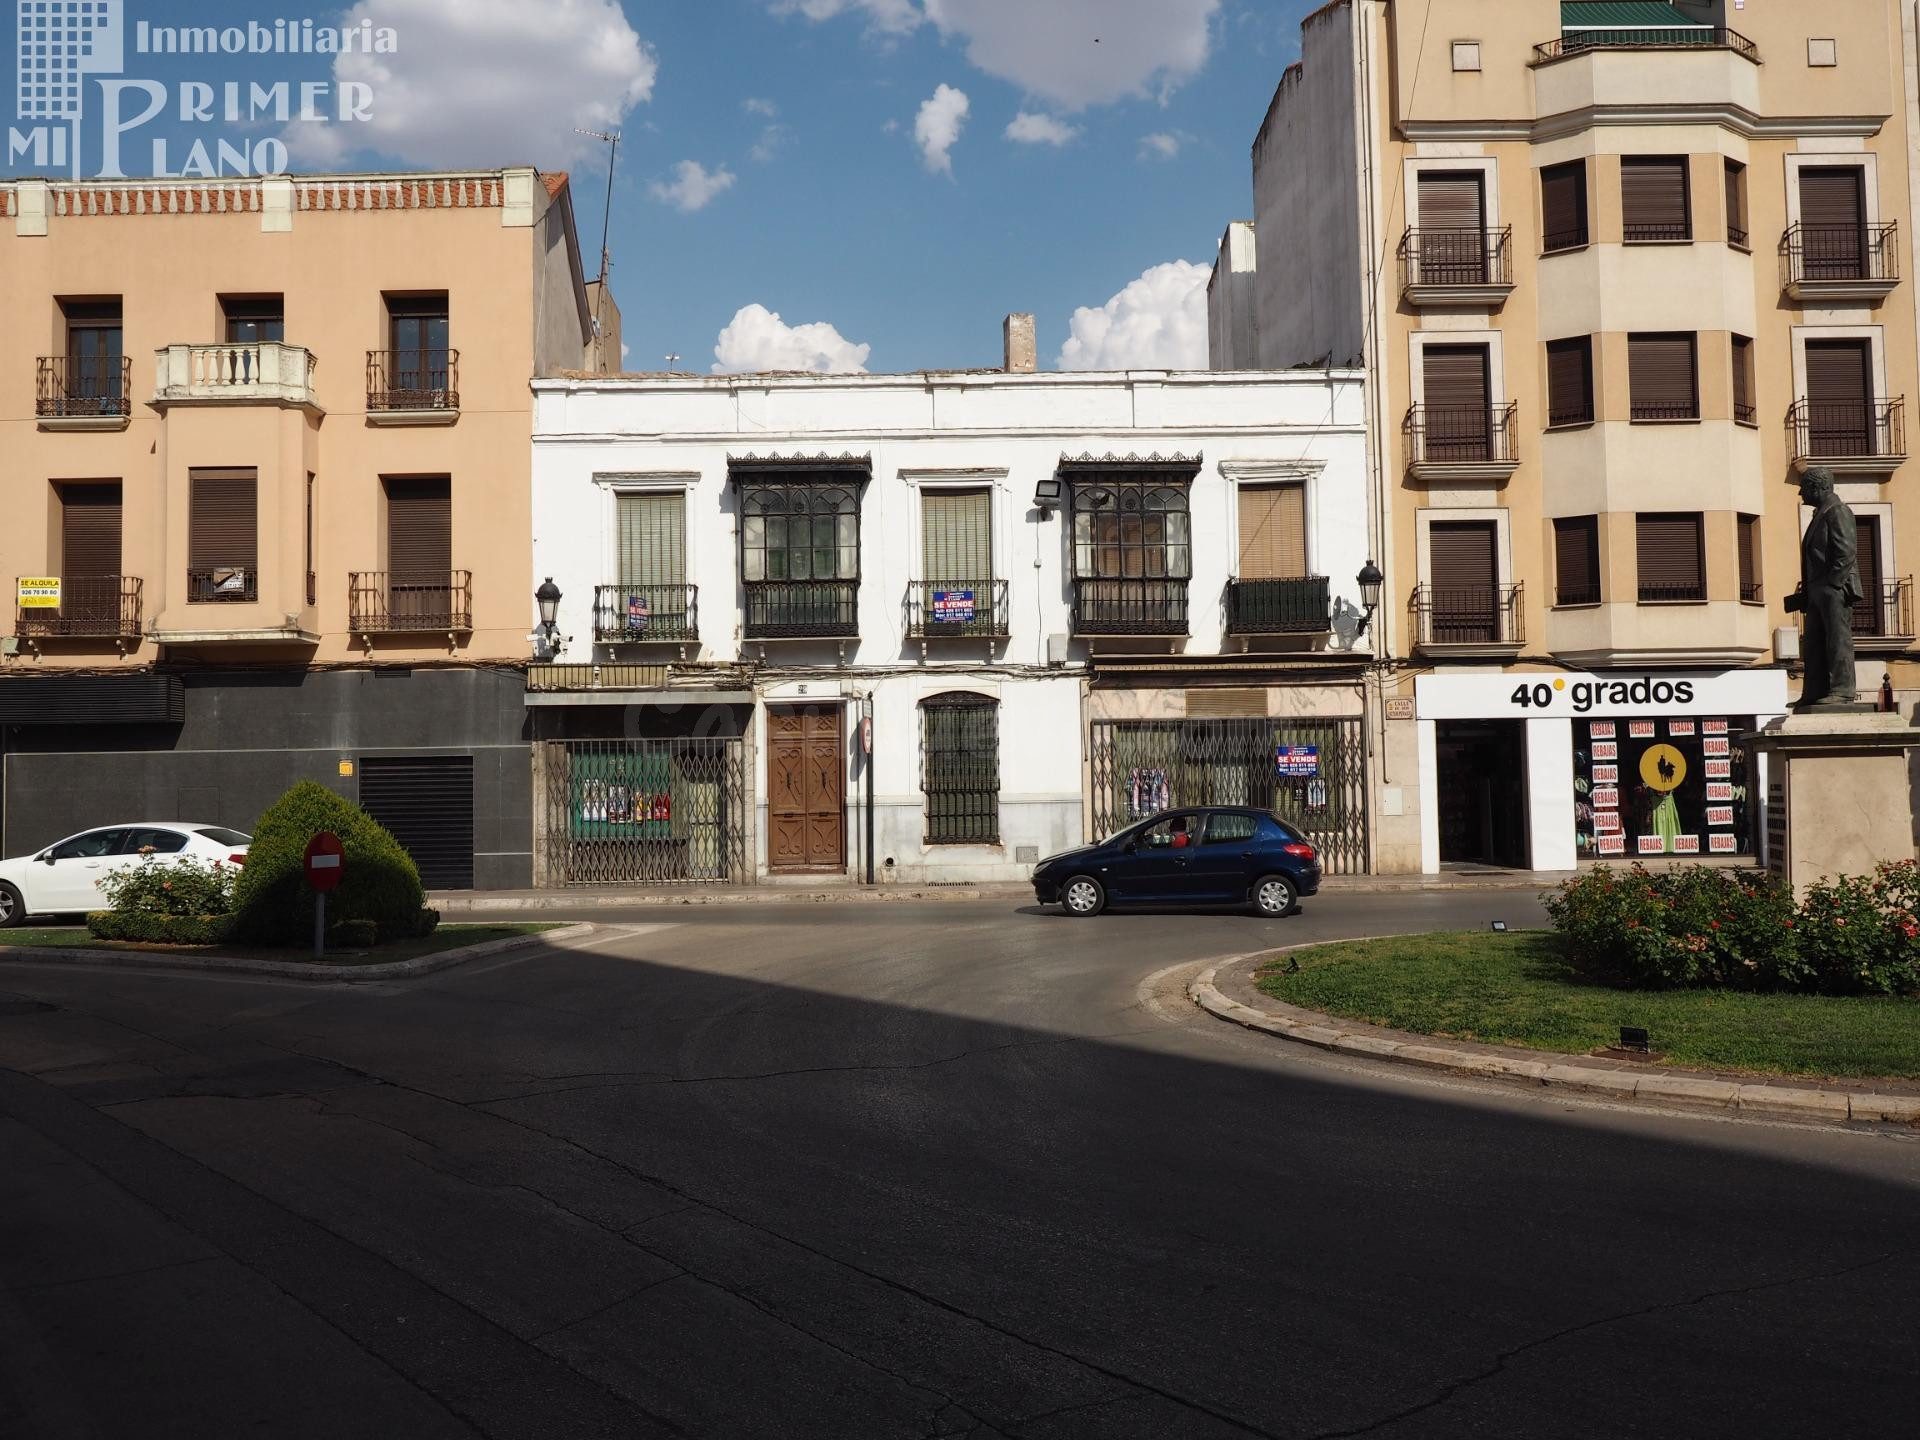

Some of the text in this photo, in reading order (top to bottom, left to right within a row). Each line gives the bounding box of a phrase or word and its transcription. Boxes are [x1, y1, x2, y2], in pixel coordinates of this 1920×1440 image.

[946, 600, 973, 608] VENDE
[1572, 676, 1694, 713] grados
[1593, 745, 1616, 757] REBAJAS
[1705, 741, 1727, 753] REBAJAS
[1594, 768, 1617, 780] REBAJAS
[1707, 763, 1729, 775] REBAJAS
[1595, 792, 1617, 804] REBAJAS
[1708, 786, 1731, 798] REBAJAS
[1595, 815, 1618, 827] REBAJAS
[1709, 809, 1732, 822] REBAJAS
[1600, 838, 1623, 851] REBAJAS
[1640, 838, 1662, 850] REBAJAS
[1675, 838, 1698, 850] REBAJAS
[1711, 837, 1734, 849] REBAJAS
